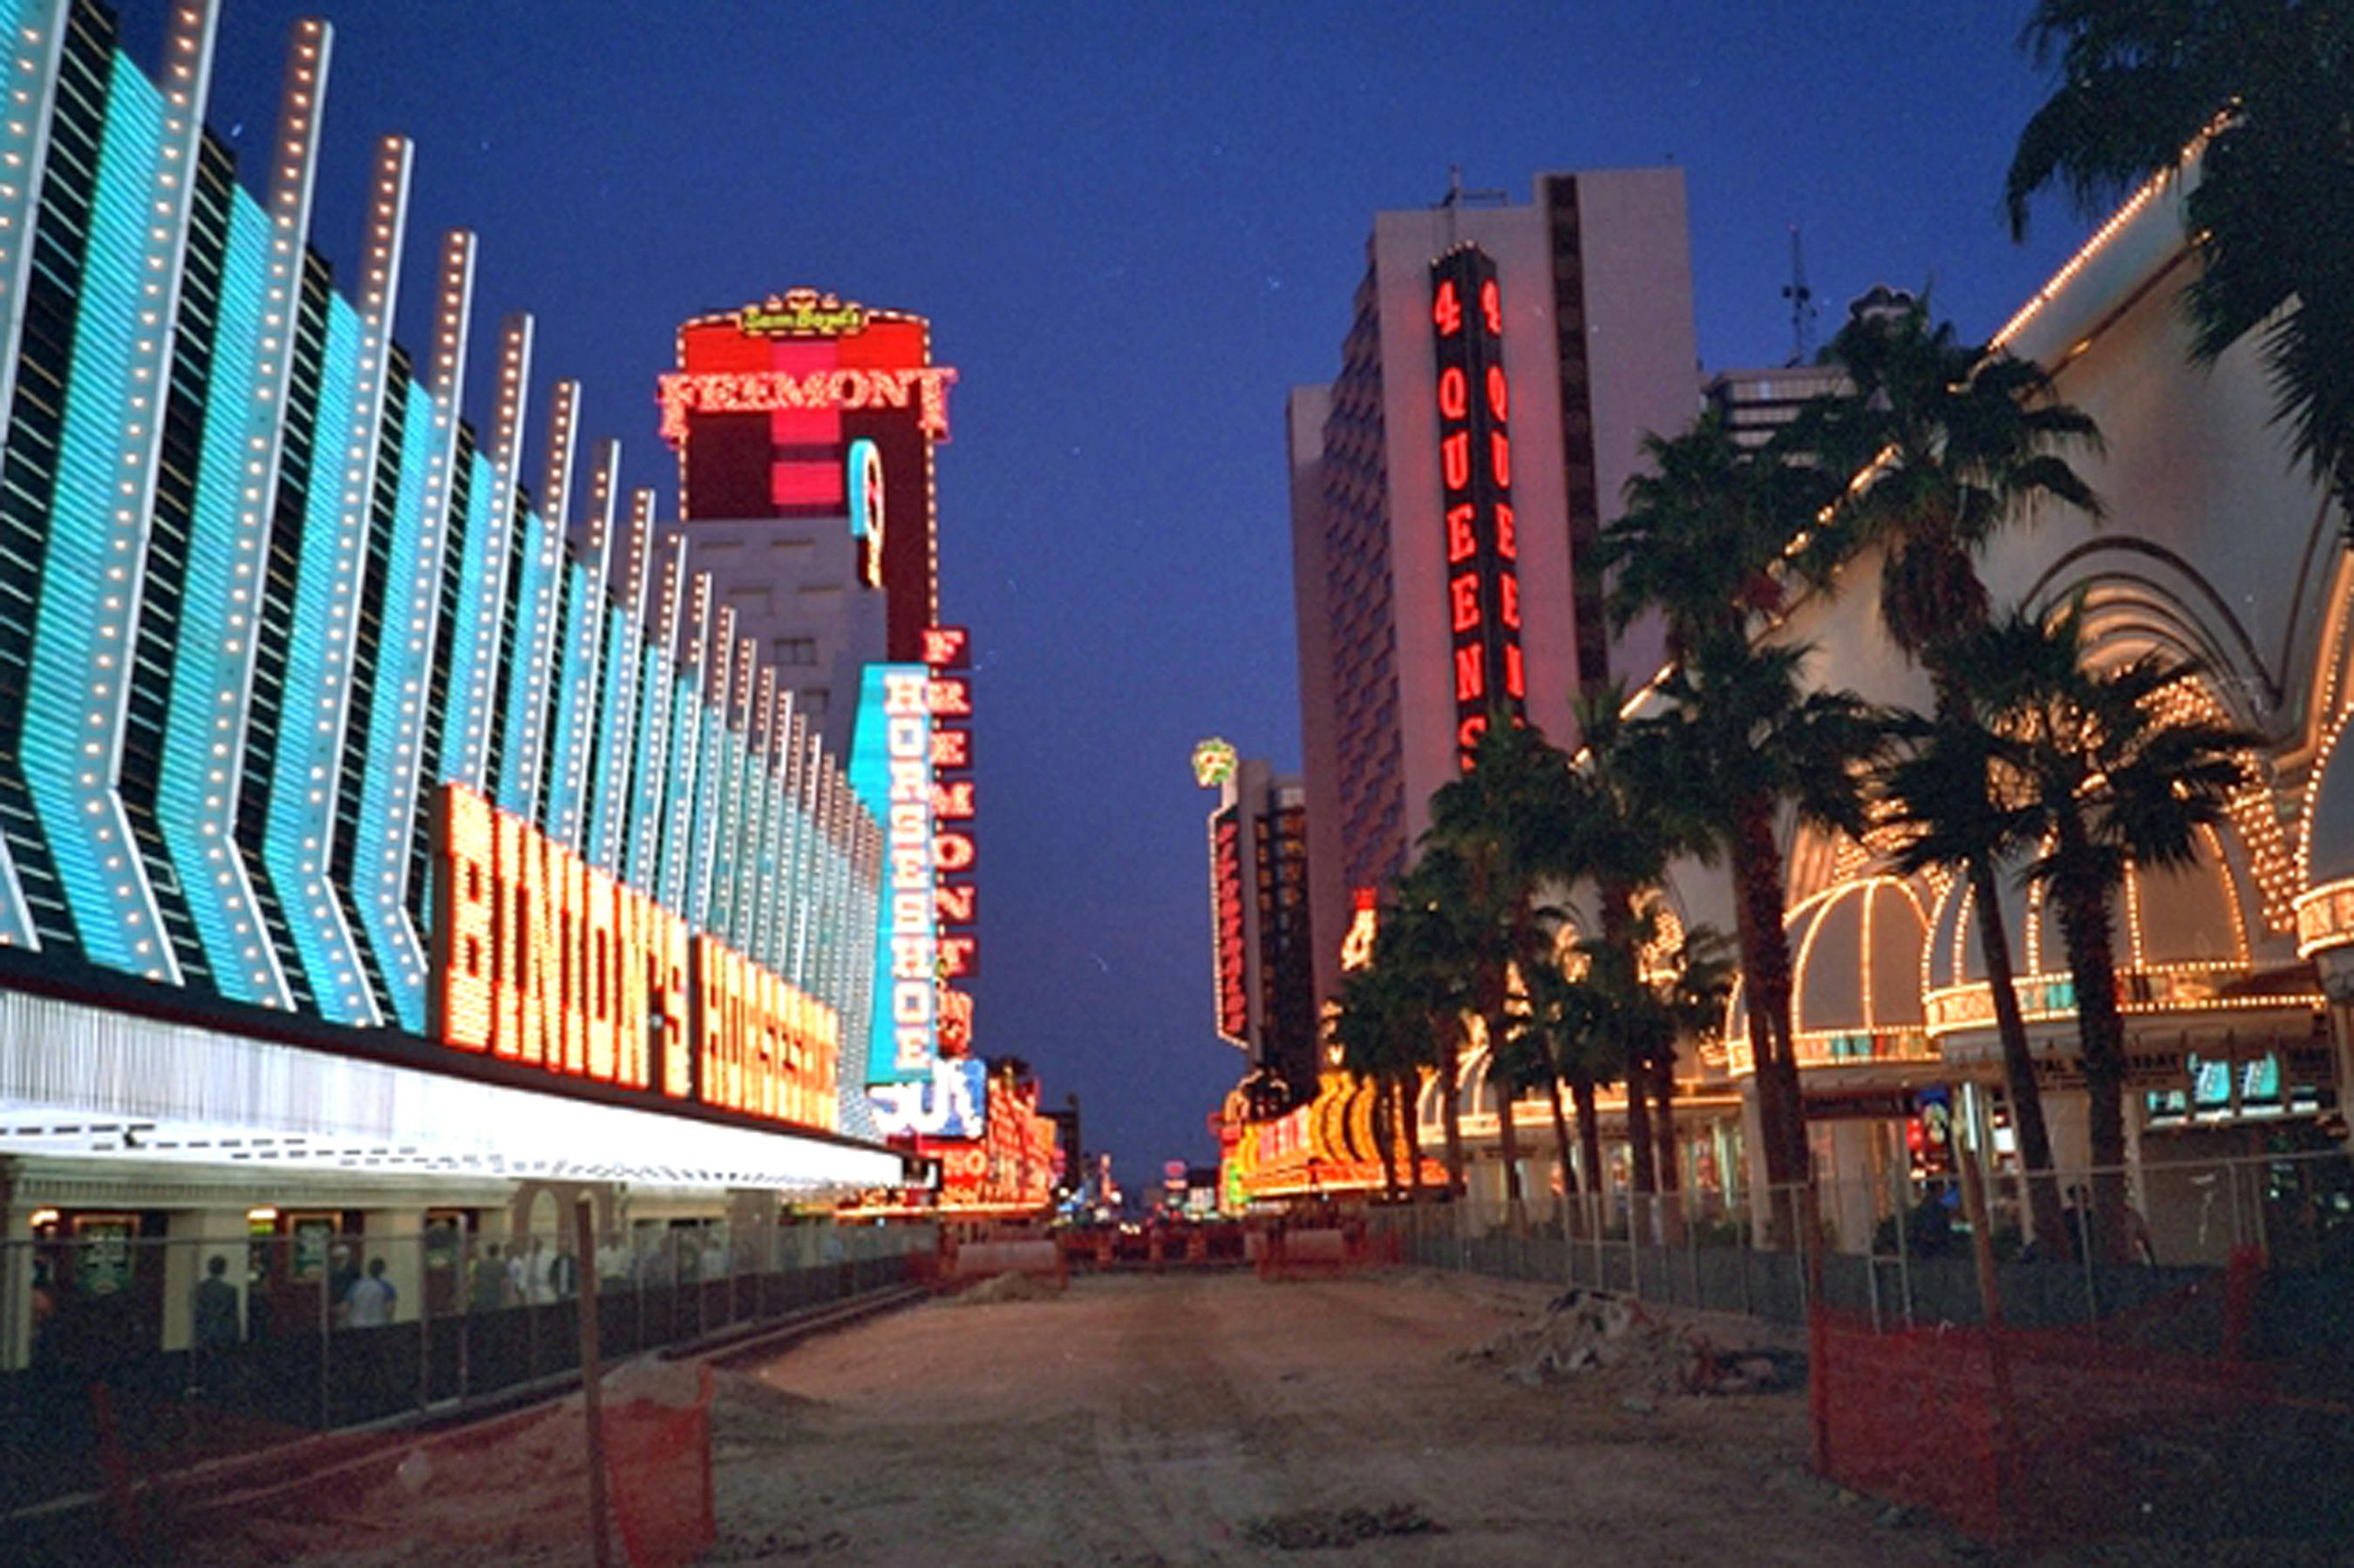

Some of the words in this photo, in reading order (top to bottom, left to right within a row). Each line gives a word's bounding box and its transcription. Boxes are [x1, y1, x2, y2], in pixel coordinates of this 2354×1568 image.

[657, 367, 958, 444] FREMONT
[1433, 280, 1461, 336] 4
[443, 781, 691, 1099] BINION'S
[883, 672, 935, 1070] HORSESHOE
